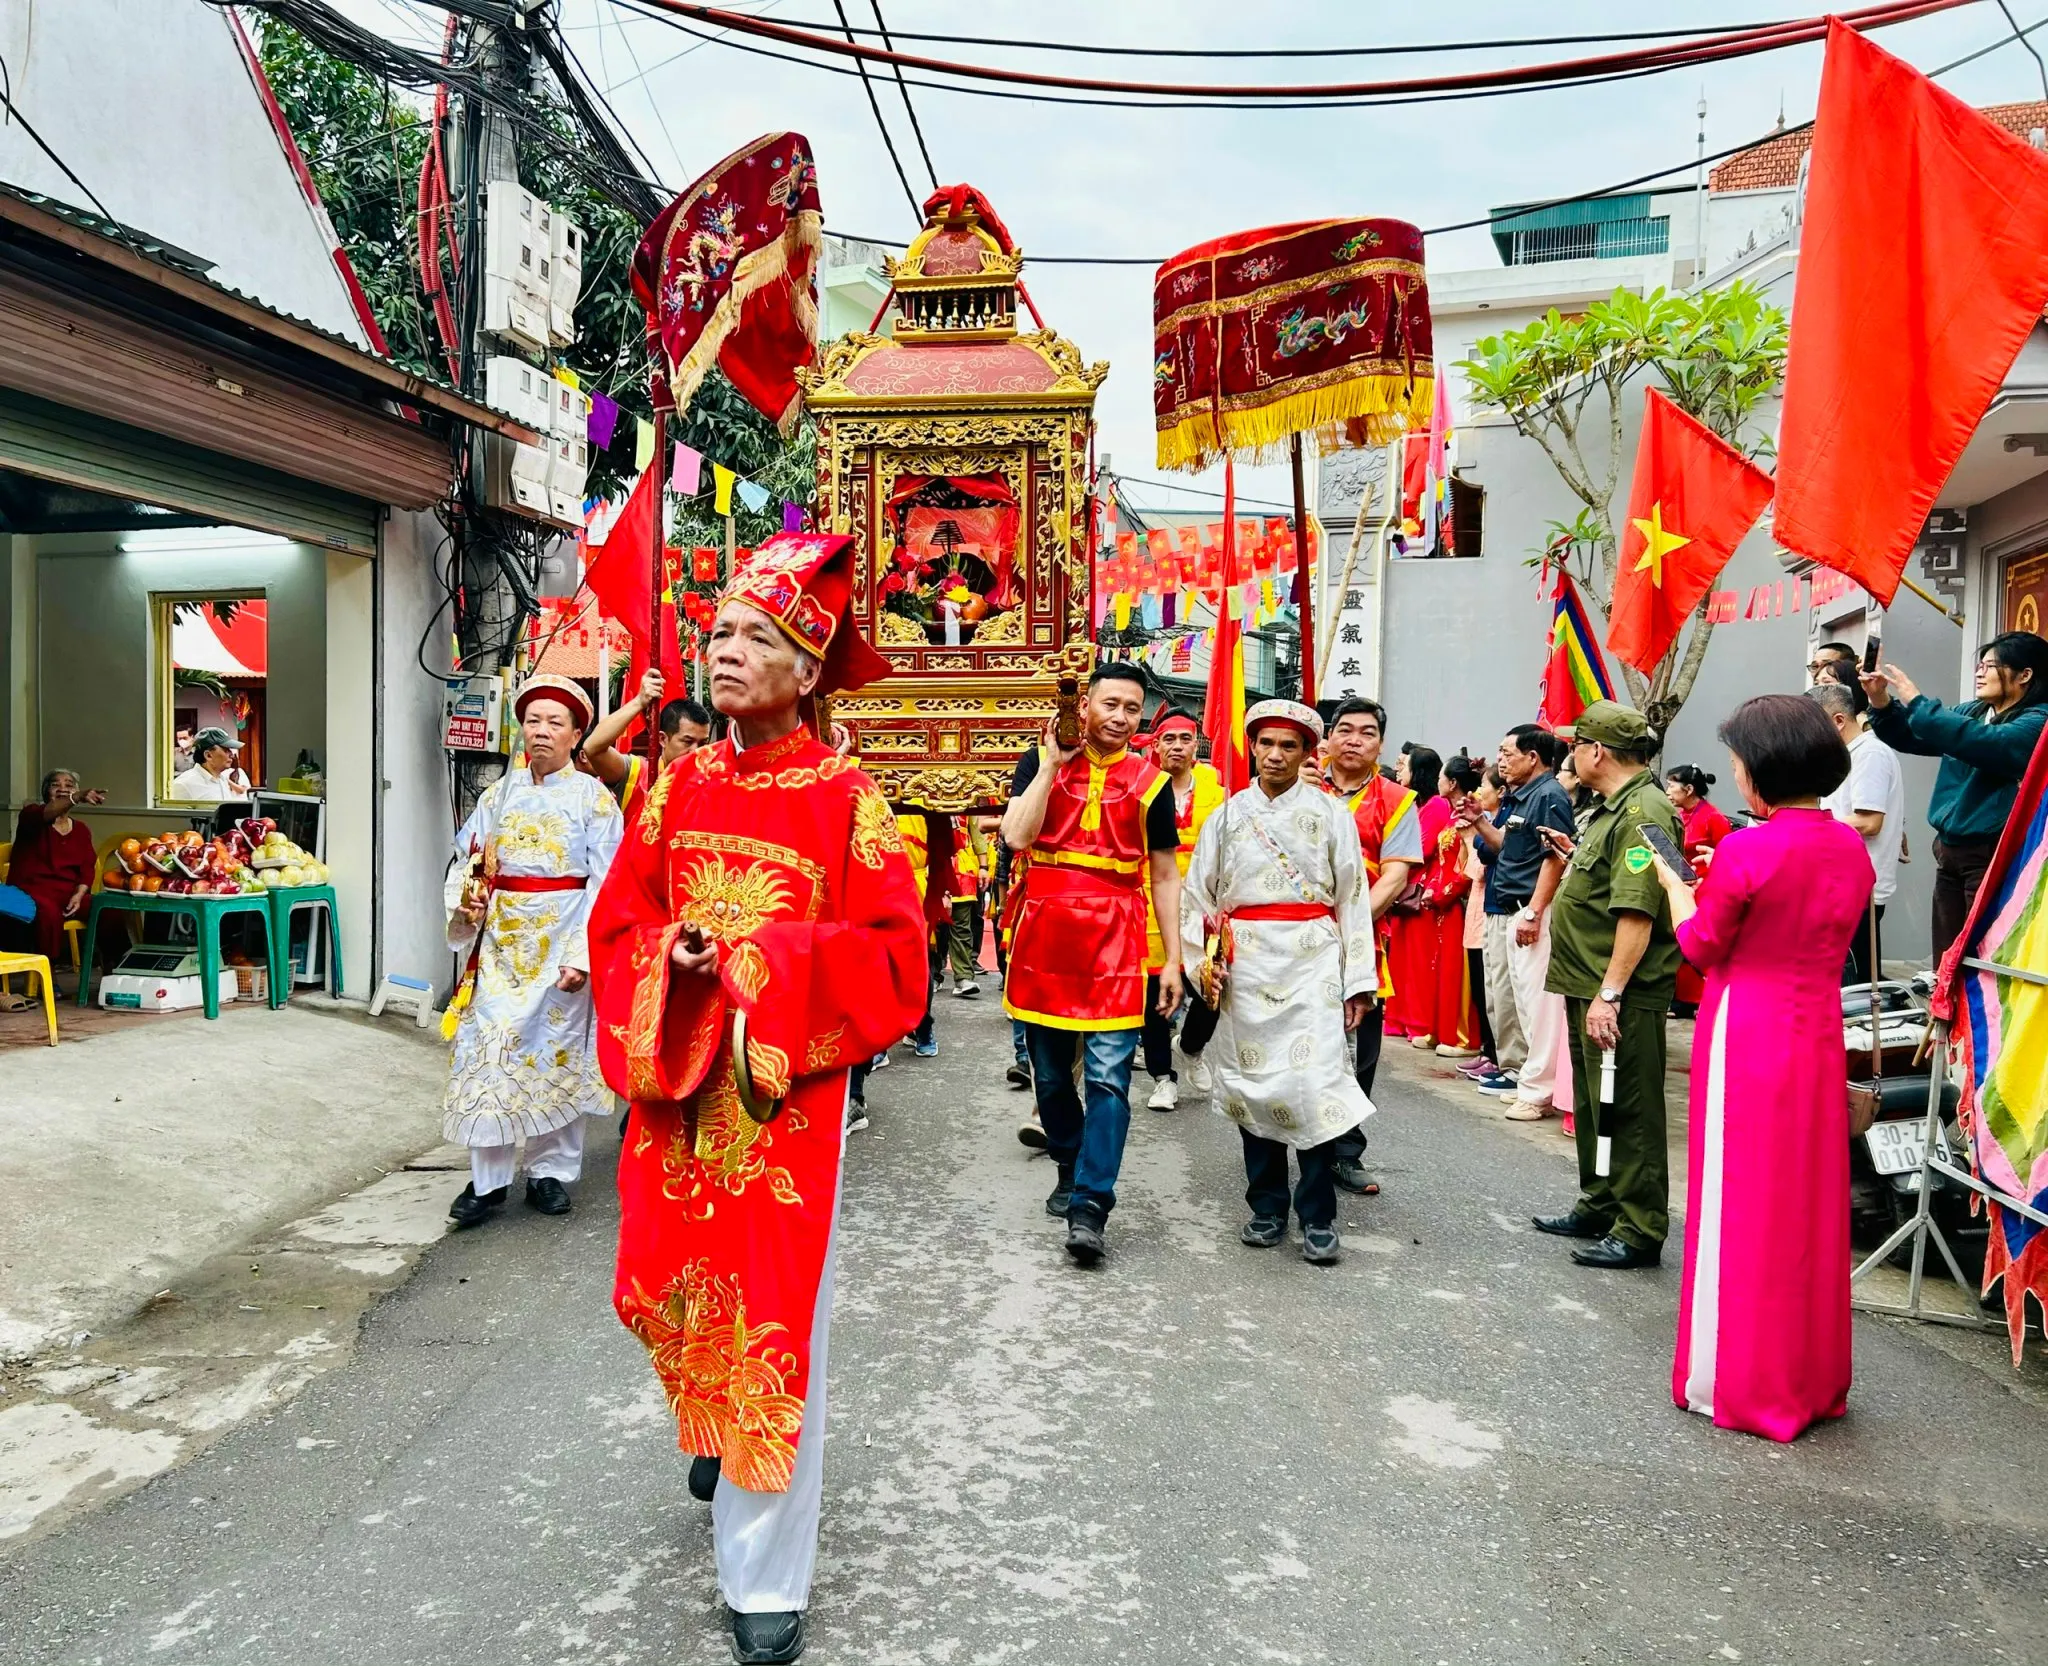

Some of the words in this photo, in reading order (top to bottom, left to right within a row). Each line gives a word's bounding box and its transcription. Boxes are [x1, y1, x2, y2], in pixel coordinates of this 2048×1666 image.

[1880, 1035, 1912, 1043] ONDA
[1877, 1121, 1927, 1146] 30-Z
[1878, 1143, 1948, 1169] 010.6
